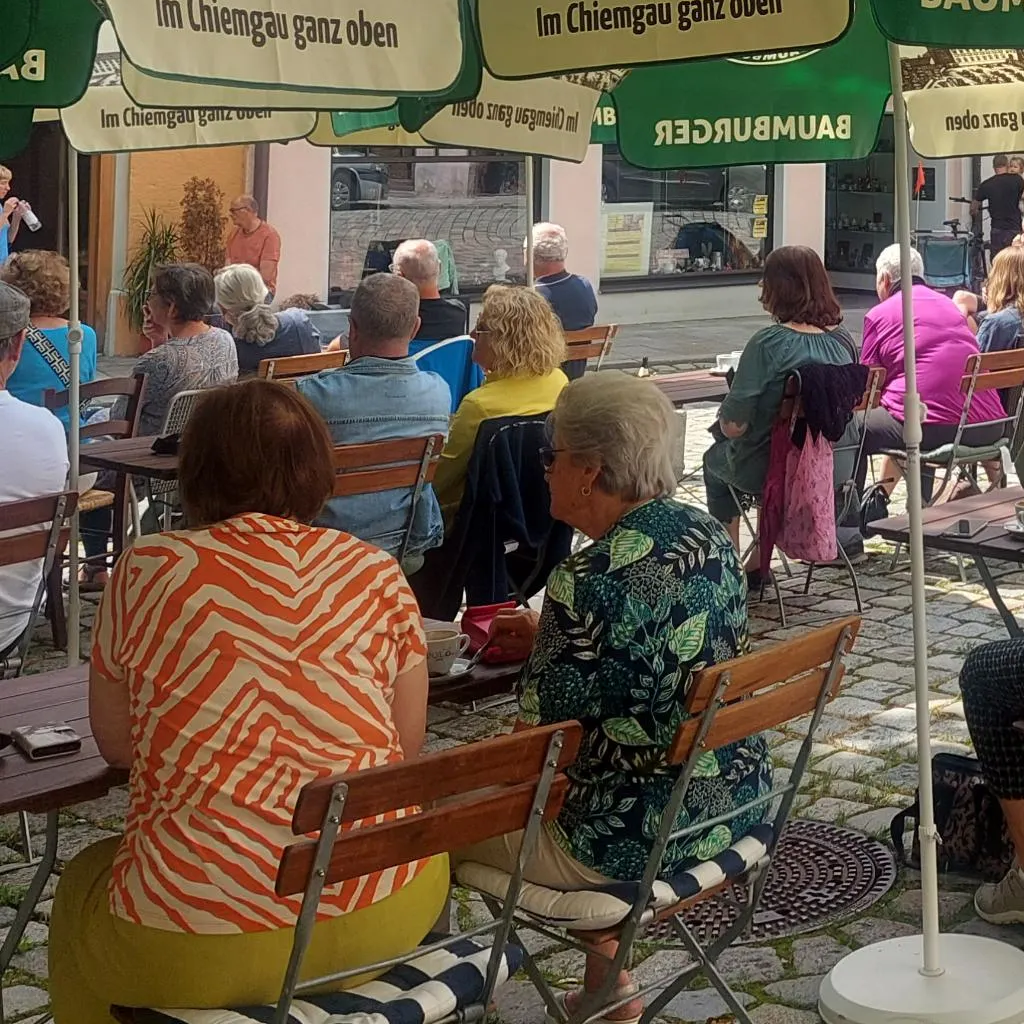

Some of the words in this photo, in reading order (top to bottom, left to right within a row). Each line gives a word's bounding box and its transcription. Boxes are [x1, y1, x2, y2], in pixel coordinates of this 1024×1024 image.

[293, 14, 343, 50] ganz
[347, 10, 399, 48] oben
[537, 7, 561, 37] Im
[567, 0, 672, 35] Chiemgau
[101, 108, 119, 128] Im
[123, 107, 195, 129] Chiemgau
